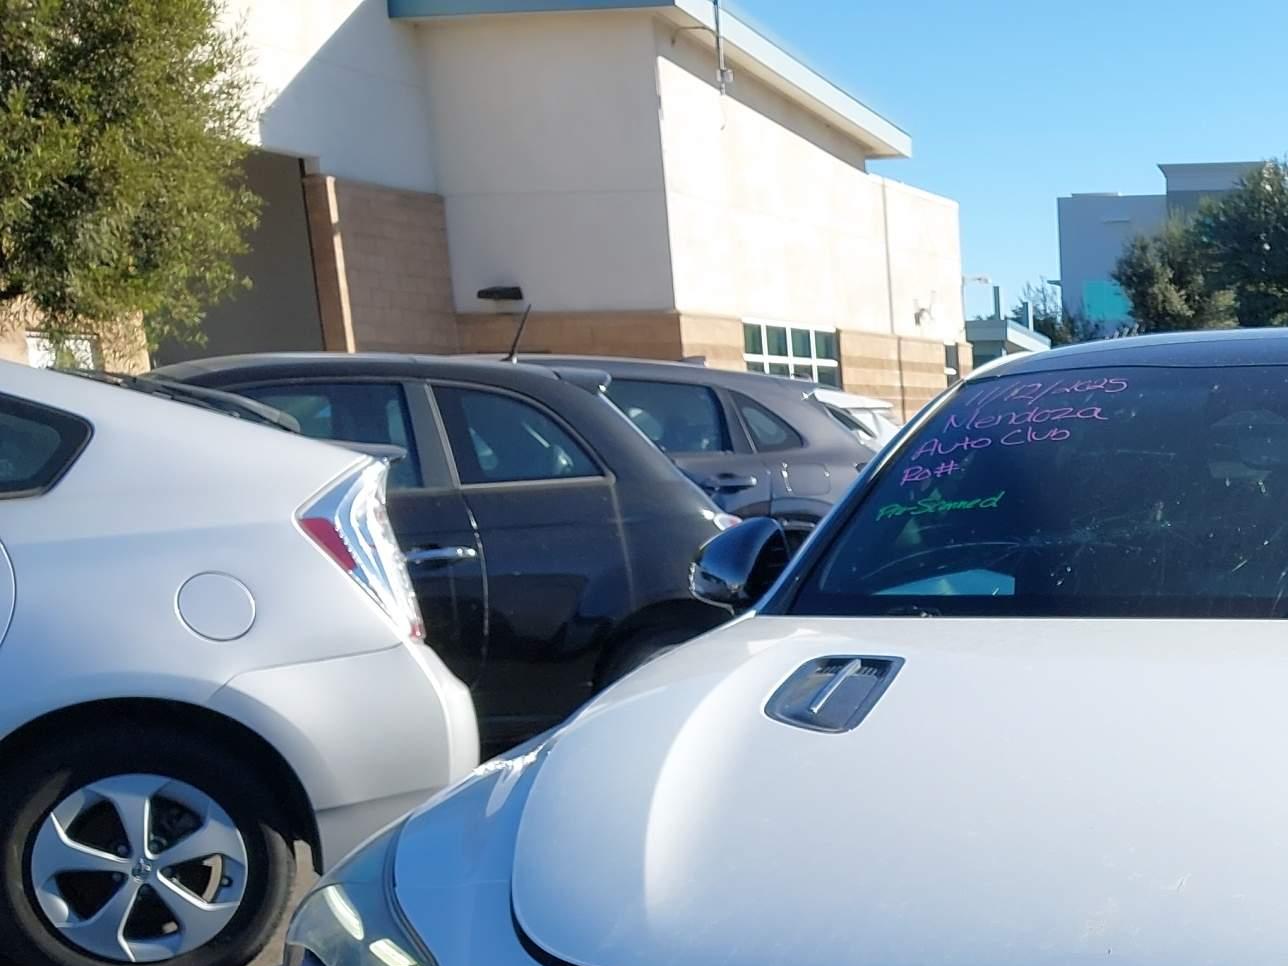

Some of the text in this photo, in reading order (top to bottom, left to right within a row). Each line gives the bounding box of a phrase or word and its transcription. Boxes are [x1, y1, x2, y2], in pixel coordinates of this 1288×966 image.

[945, 407, 1109, 433] Mendoza
[912, 427, 1071, 460] Auto Club
